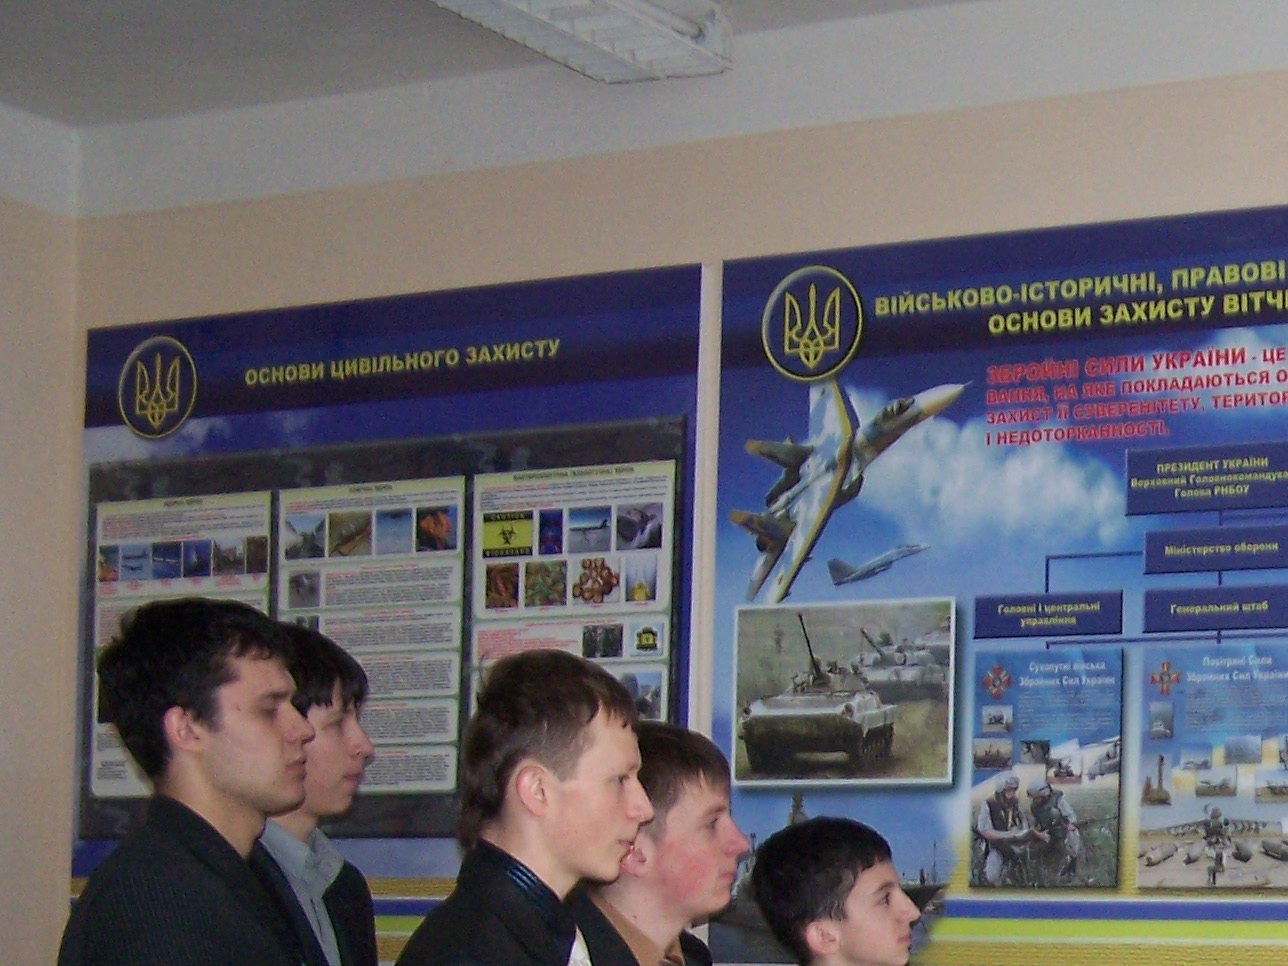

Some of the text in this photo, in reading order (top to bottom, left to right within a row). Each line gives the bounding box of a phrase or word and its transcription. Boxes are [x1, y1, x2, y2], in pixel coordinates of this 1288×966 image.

[875, 271, 1163, 316] ВІЙСЬКОВО-ІСТОРИЧНІ,
[1172, 260, 1286, 289] ПРАВОВІ
[988, 307, 1092, 335] ОСНОВИ
[1100, 295, 1216, 325] ЗАХИСТУ
[244, 338, 561, 386] ОСНОВИ ЦИВІЛЬНОГО ЗАХИСТУ
[1085, 355, 1146, 378] СИЛИ
[1151, 345, 1247, 371] УКРАЇНИ
[1262, 347, 1287, 363] ЦЕ
[1053, 384, 1079, 402] НА
[1083, 381, 1116, 400] ЯКЕ
[1122, 369, 1271, 395] ПОКЛАДАЮТЬСЯ
[986, 406, 1054, 425] ЗАХИСТ
[1074, 394, 1205, 420] СУВЕРЕНІТЕТУ,
[1156, 457, 1270, 474] ПРЕЗИДЕНТ УКРАЇНИ
[1214, 484, 1249, 495] РНБОУ
